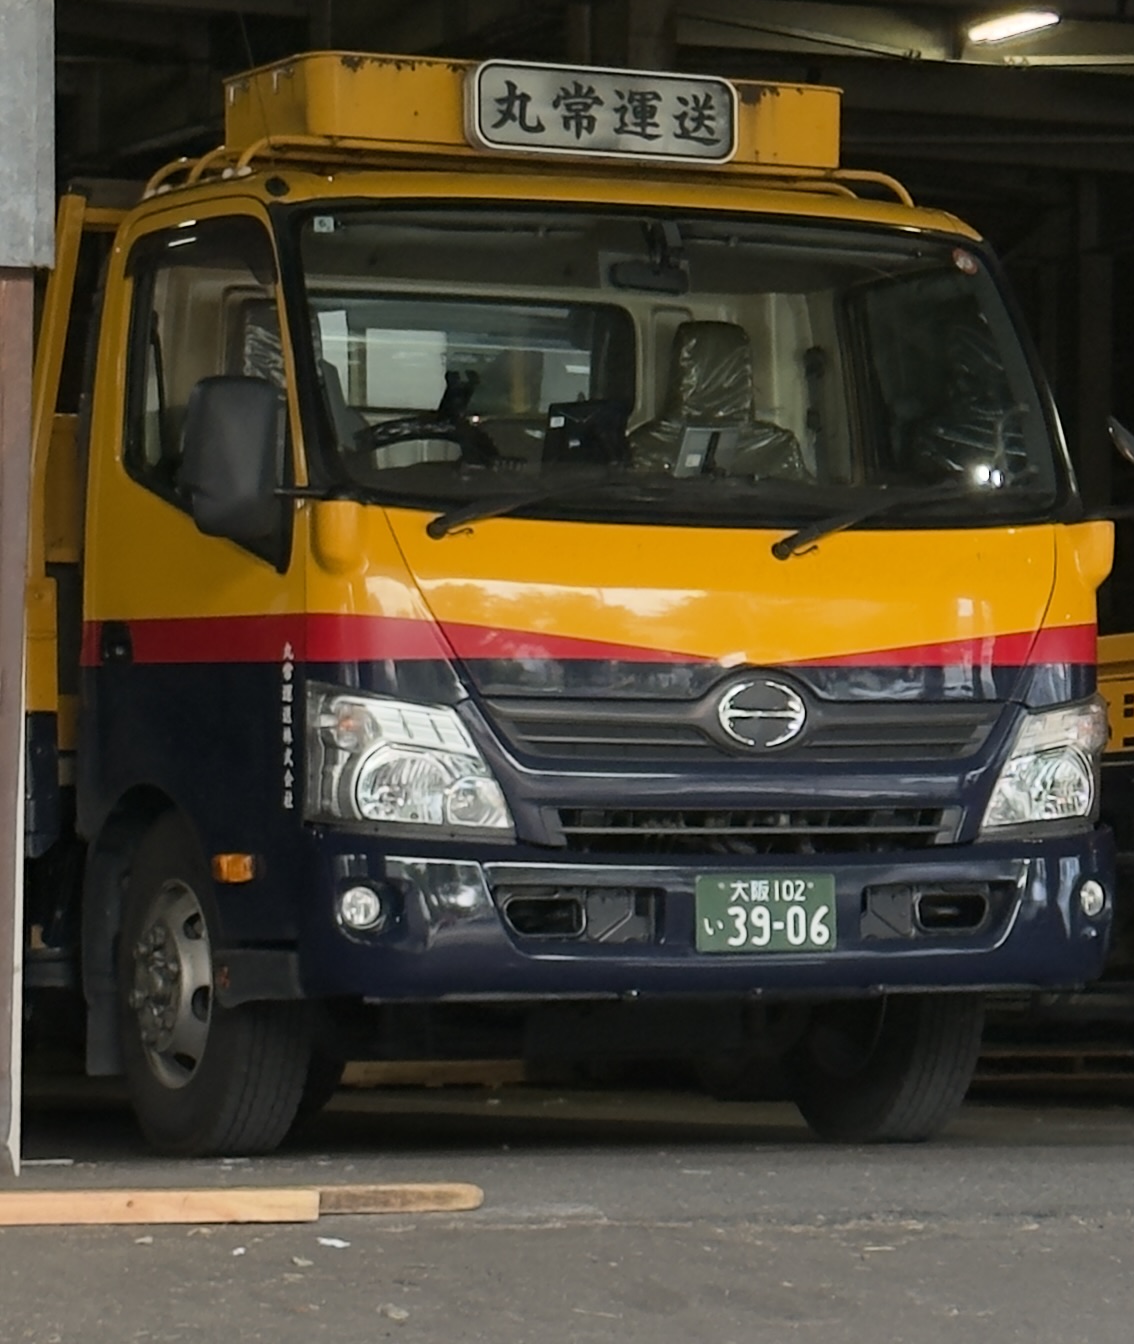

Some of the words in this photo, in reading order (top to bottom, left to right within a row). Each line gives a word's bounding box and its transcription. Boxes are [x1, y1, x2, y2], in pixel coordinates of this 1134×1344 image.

[491, 80, 721, 146] 丸常運送
[727, 905, 829, 946] 39-06
